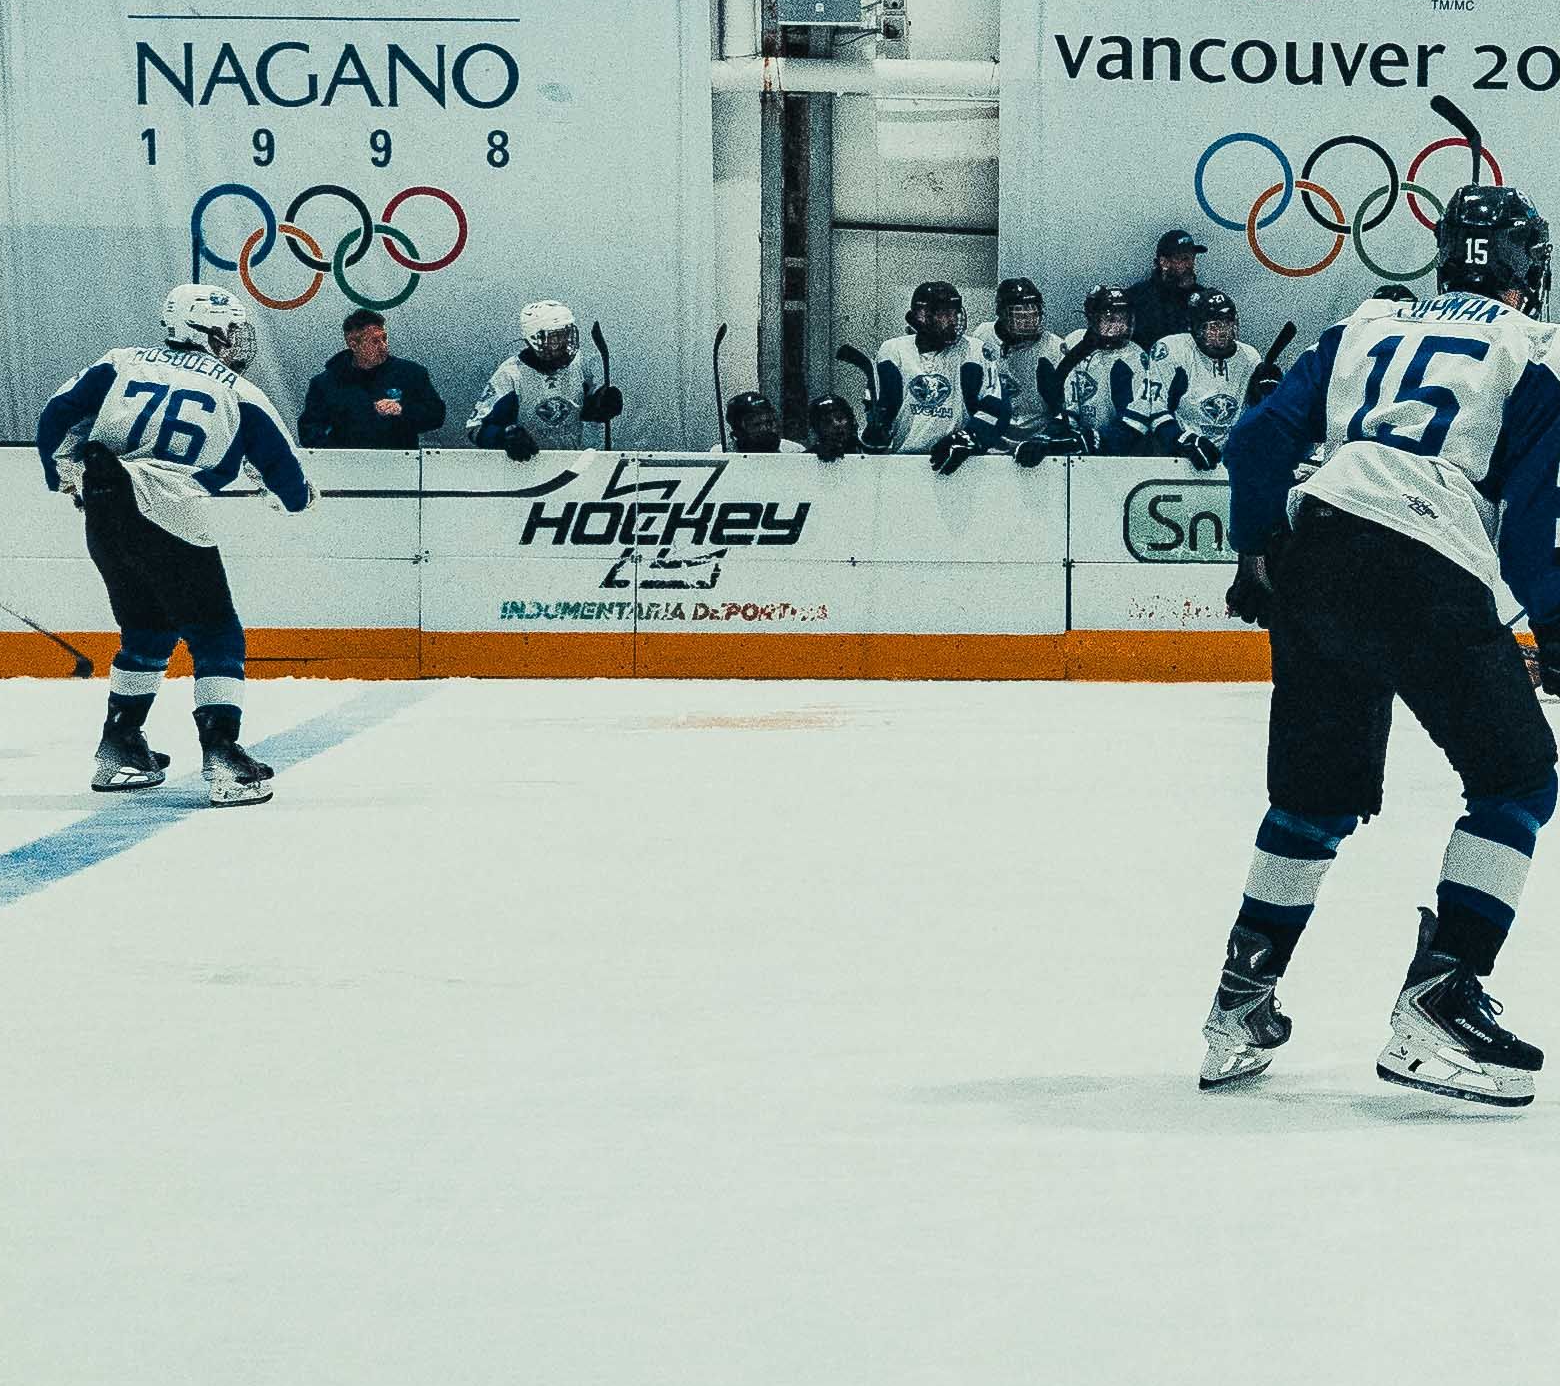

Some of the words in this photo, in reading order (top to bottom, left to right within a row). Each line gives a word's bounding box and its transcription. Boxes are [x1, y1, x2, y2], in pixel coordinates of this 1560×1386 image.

[135, 41, 520, 109] NAGANO
[1054, 33, 1446, 89] vancouver
[1464, 238, 1489, 265] 15
[123, 380, 217, 466] 76
[1345, 334, 1492, 458] 15
[1146, 493, 1229, 551] Sn
